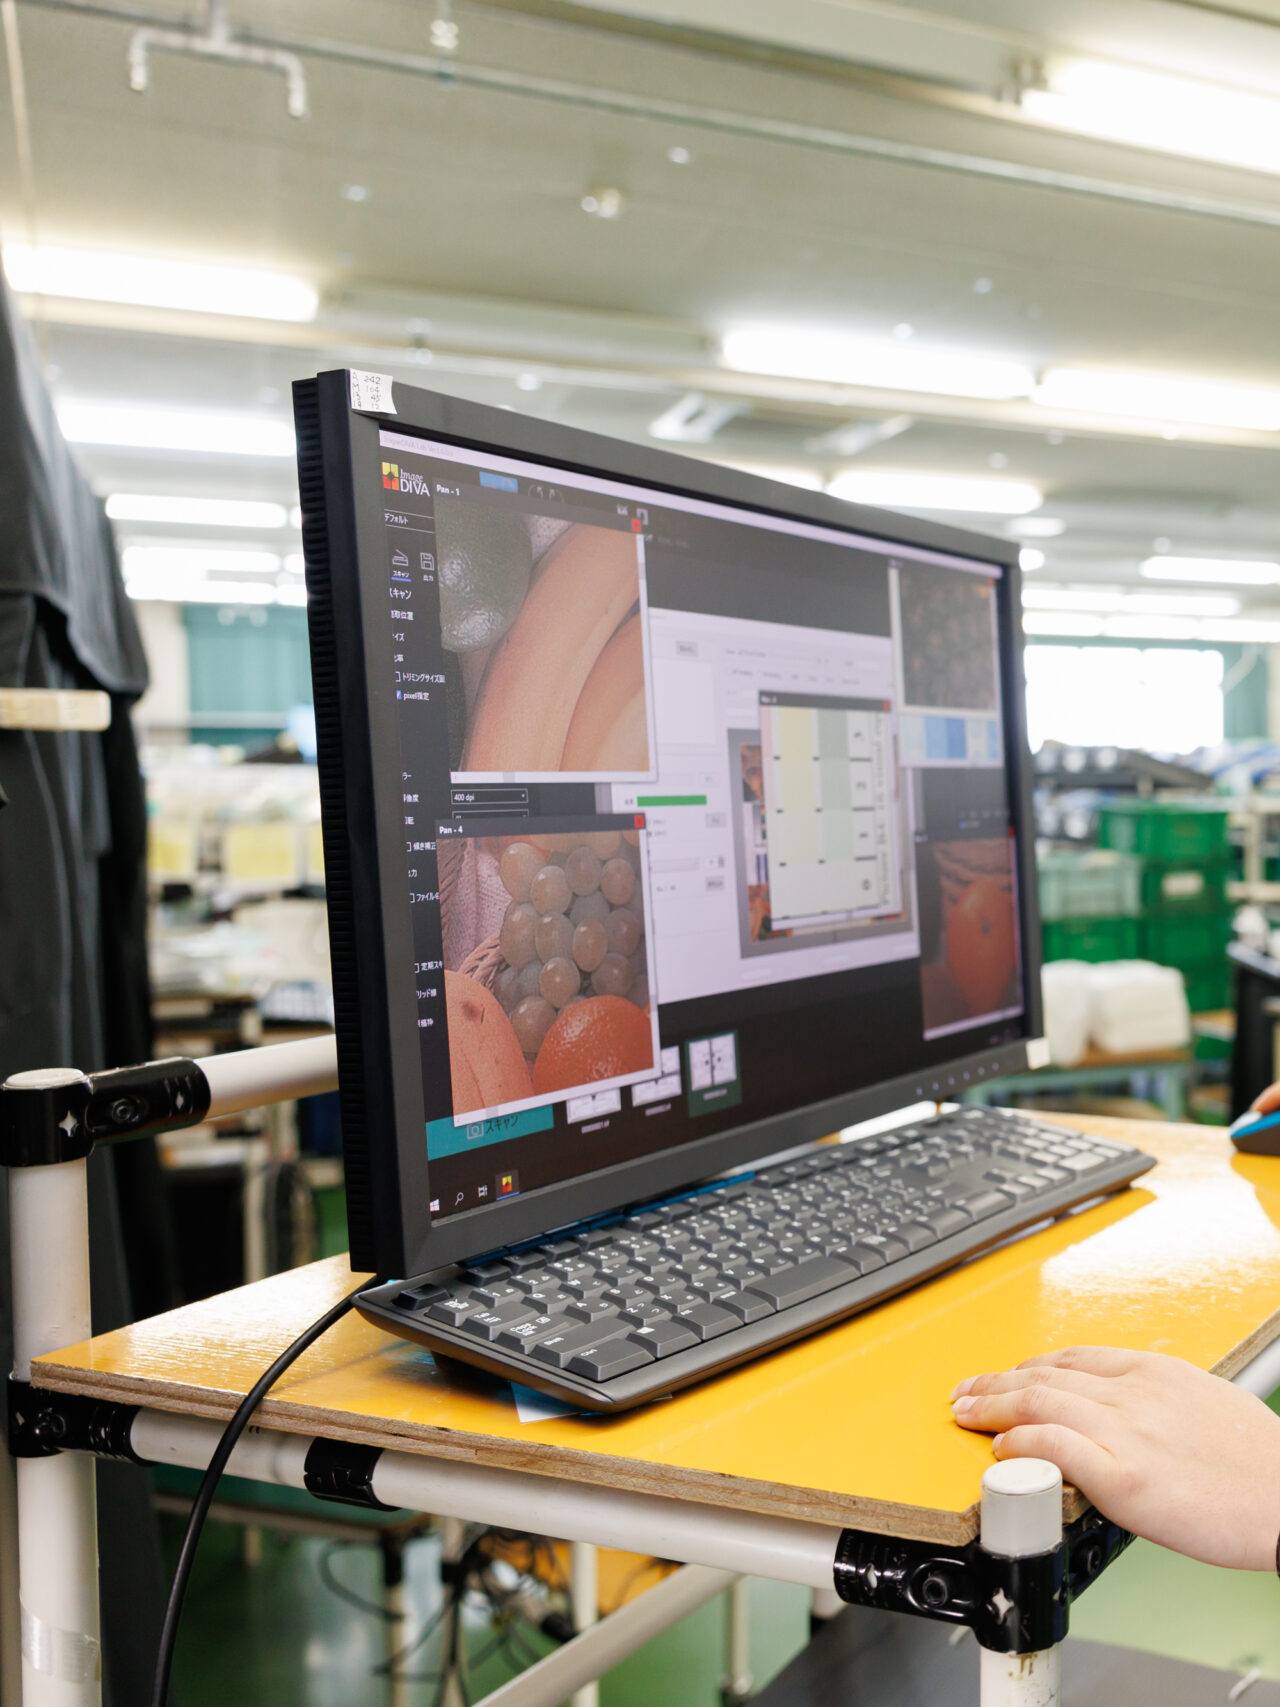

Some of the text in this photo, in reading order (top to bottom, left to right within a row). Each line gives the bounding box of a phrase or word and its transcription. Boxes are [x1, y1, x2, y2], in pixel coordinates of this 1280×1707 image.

[400, 468, 424, 483] Image
[400, 478, 430, 497] DIVA
[436, 484, 450, 495] Pan
[384, 513, 409, 525] デフォルト
[454, 793, 475, 802] 400 dpi
[439, 825, 453, 835] Pan
[484, 1113, 520, 1135] スキャン
